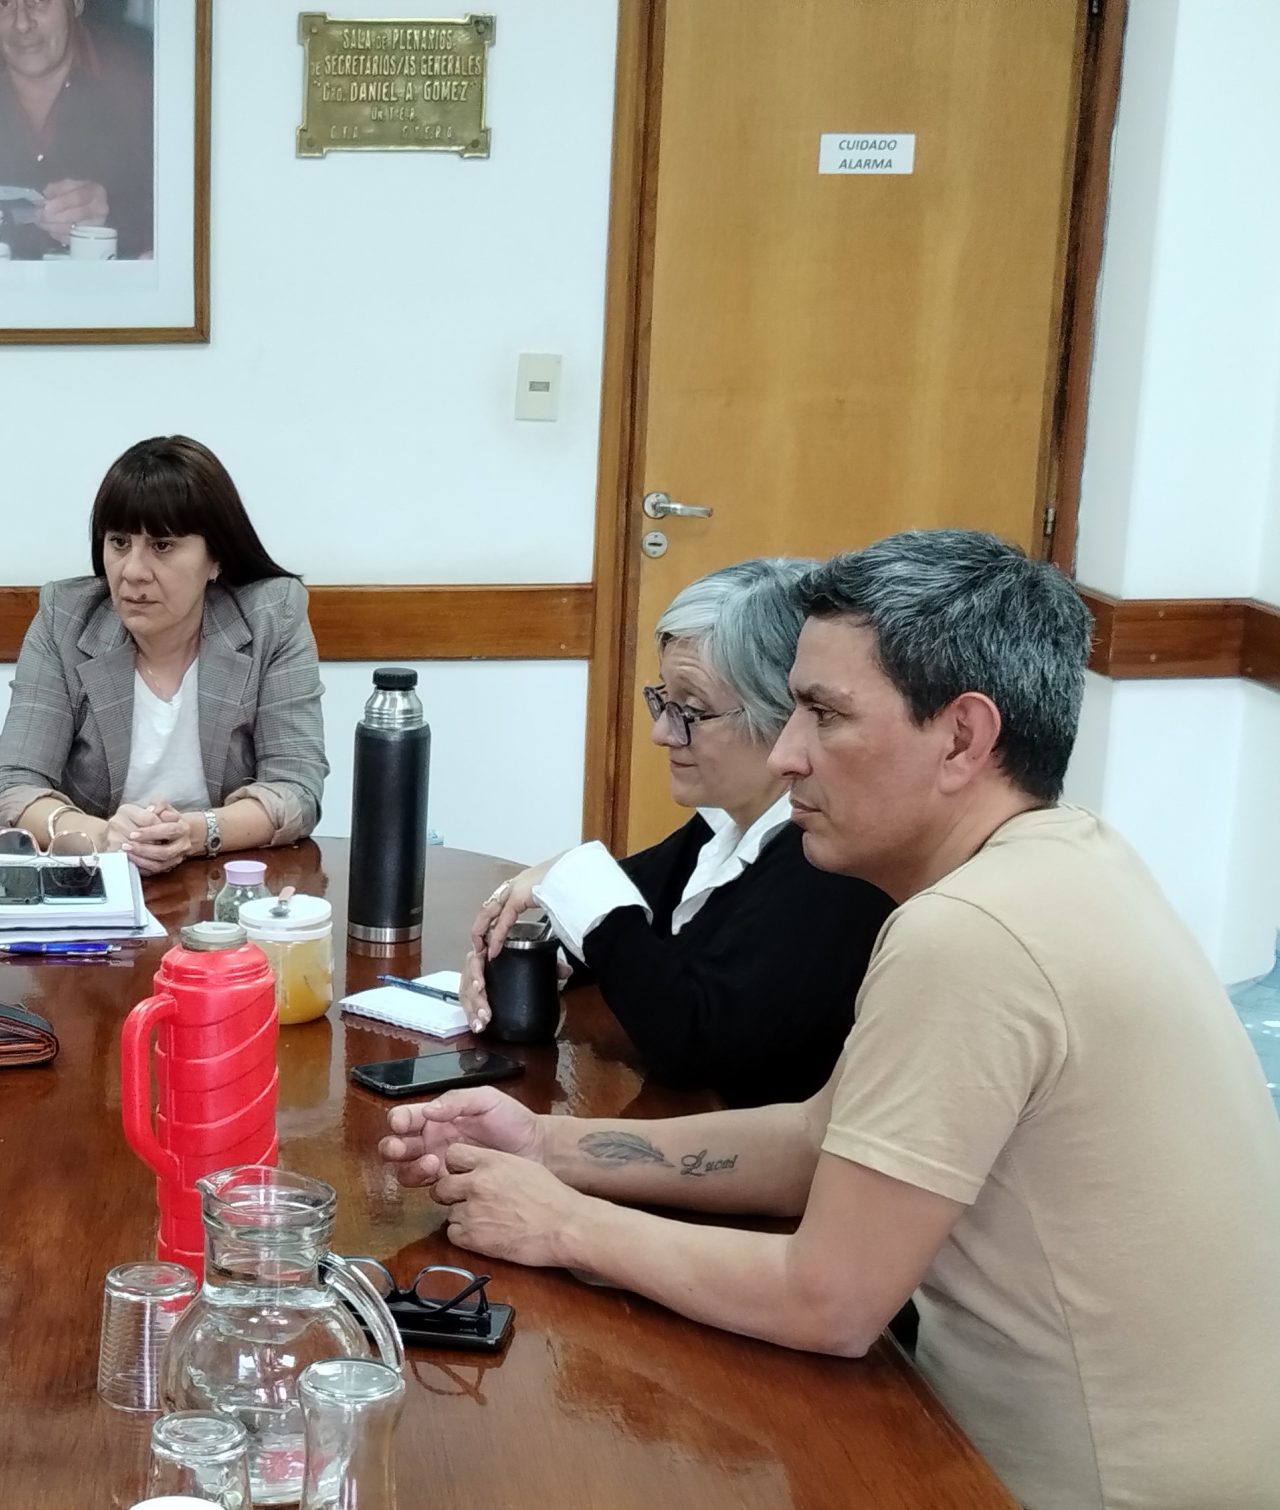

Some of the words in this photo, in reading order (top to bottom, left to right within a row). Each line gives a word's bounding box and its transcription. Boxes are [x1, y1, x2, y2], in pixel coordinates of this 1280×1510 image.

[343, 28, 371, 49] SALA
[392, 28, 452, 50] PLENARIOS
[420, 54, 481, 75] GENERALES
[350, 81, 398, 101] DANIEL
[838, 139, 897, 151] CUIDADO
[838, 158, 893, 170] ALARMA
